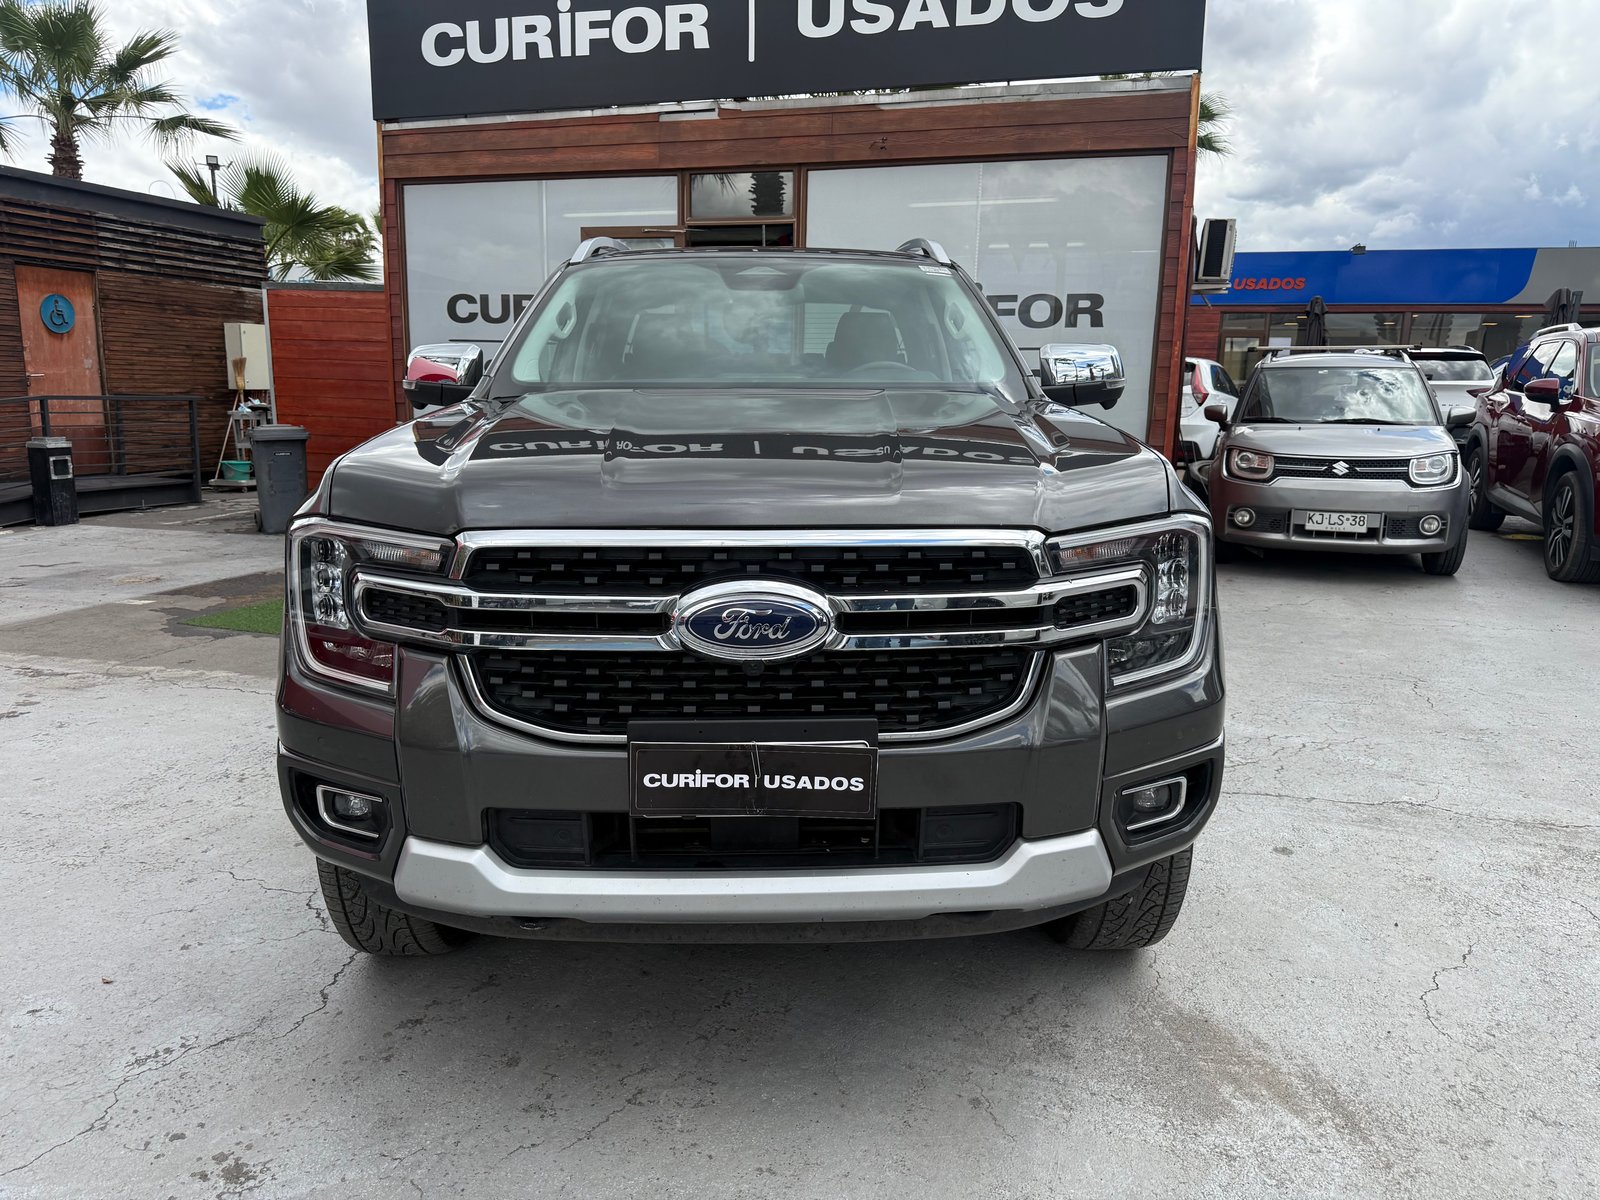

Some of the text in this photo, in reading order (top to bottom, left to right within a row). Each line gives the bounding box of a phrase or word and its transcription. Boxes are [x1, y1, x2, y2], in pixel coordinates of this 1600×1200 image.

[1233, 277, 1306, 290] USADOS
[713, 607, 793, 640] Ford
[763, 774, 865, 792] USADOS
